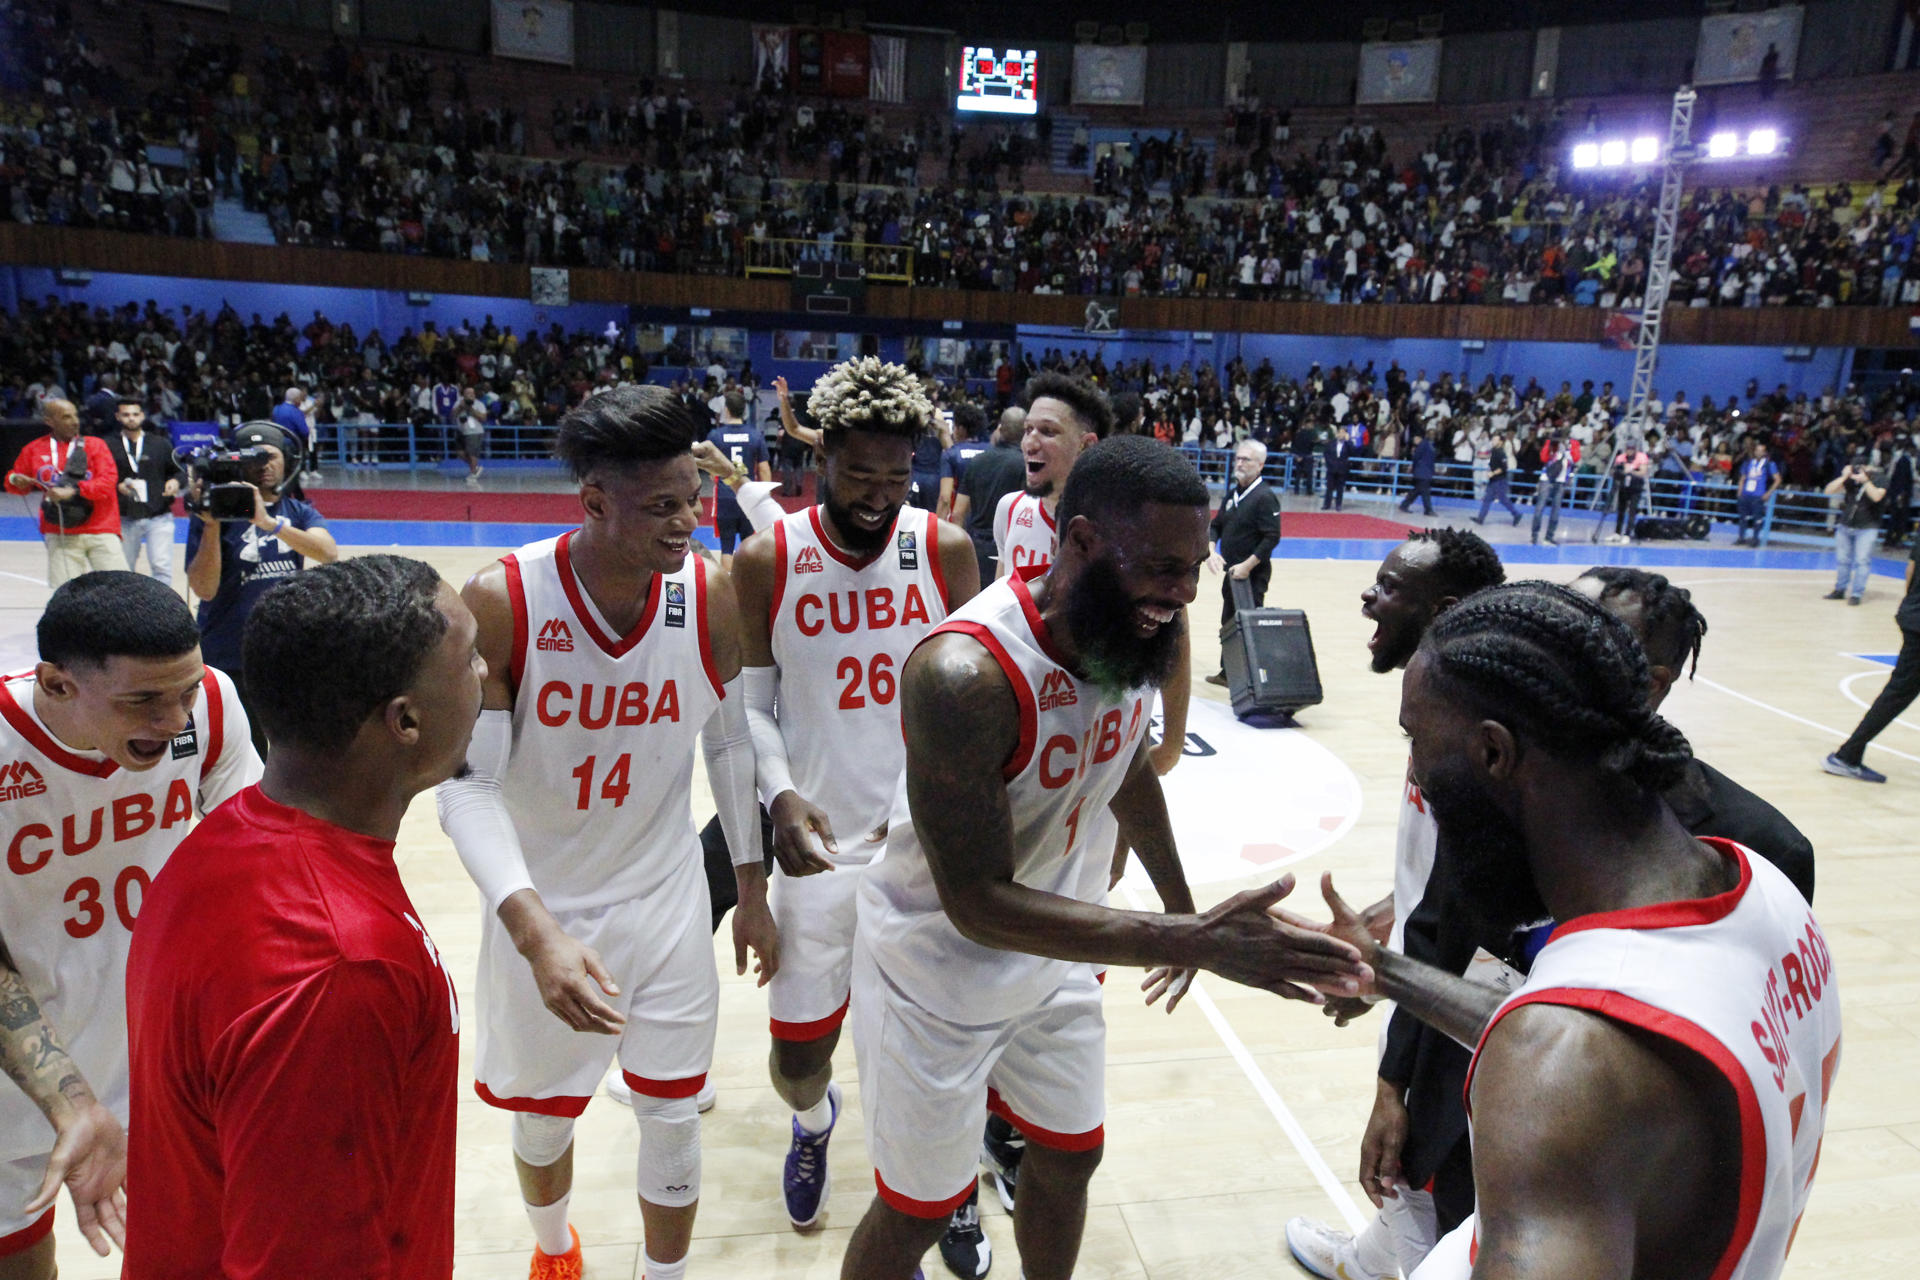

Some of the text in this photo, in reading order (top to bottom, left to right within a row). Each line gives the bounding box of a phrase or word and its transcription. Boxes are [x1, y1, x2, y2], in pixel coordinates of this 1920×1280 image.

[795, 561, 824, 574] EMES
[668, 607, 683, 616] FIBA
[795, 583, 930, 637] CUBA
[536, 637, 574, 652] EMES
[536, 679, 680, 730] CUBA
[836, 652, 896, 710] 26
[1038, 689, 1078, 712] EMES
[173, 734, 194, 747] FIBA
[1039, 697, 1142, 789] CUBA
[0, 779, 47, 802] EMES
[571, 753, 631, 810] 14
[7, 778, 193, 875] CUBA
[1063, 796, 1087, 857] 1
[63, 865, 152, 938] 30
